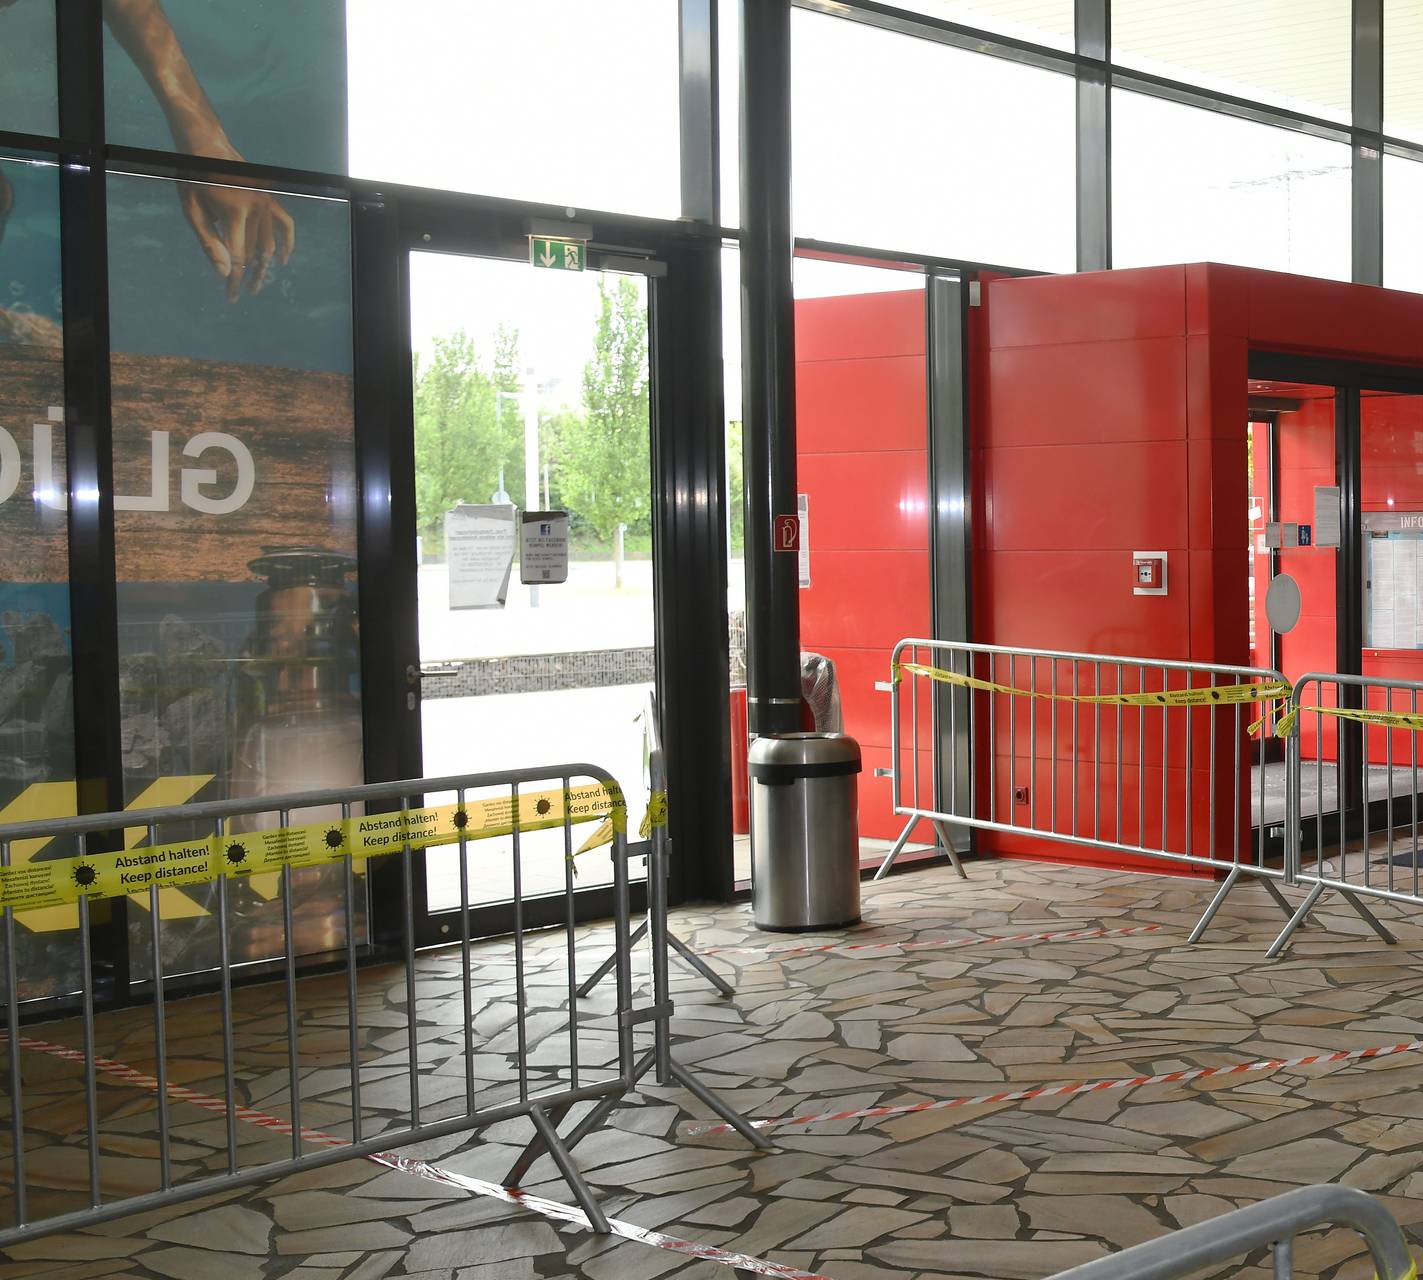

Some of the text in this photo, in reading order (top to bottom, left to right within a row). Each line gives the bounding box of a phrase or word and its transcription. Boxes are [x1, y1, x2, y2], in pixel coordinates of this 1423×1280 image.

[565, 788, 599, 802] Abstand
[567, 799, 626, 816] Keep distance
[358, 811, 439, 833] Abstand halten!
[363, 827, 437, 848] Keep distance!
[115, 845, 210, 869] Abstand halten!
[120, 861, 208, 884] Keep distance!
